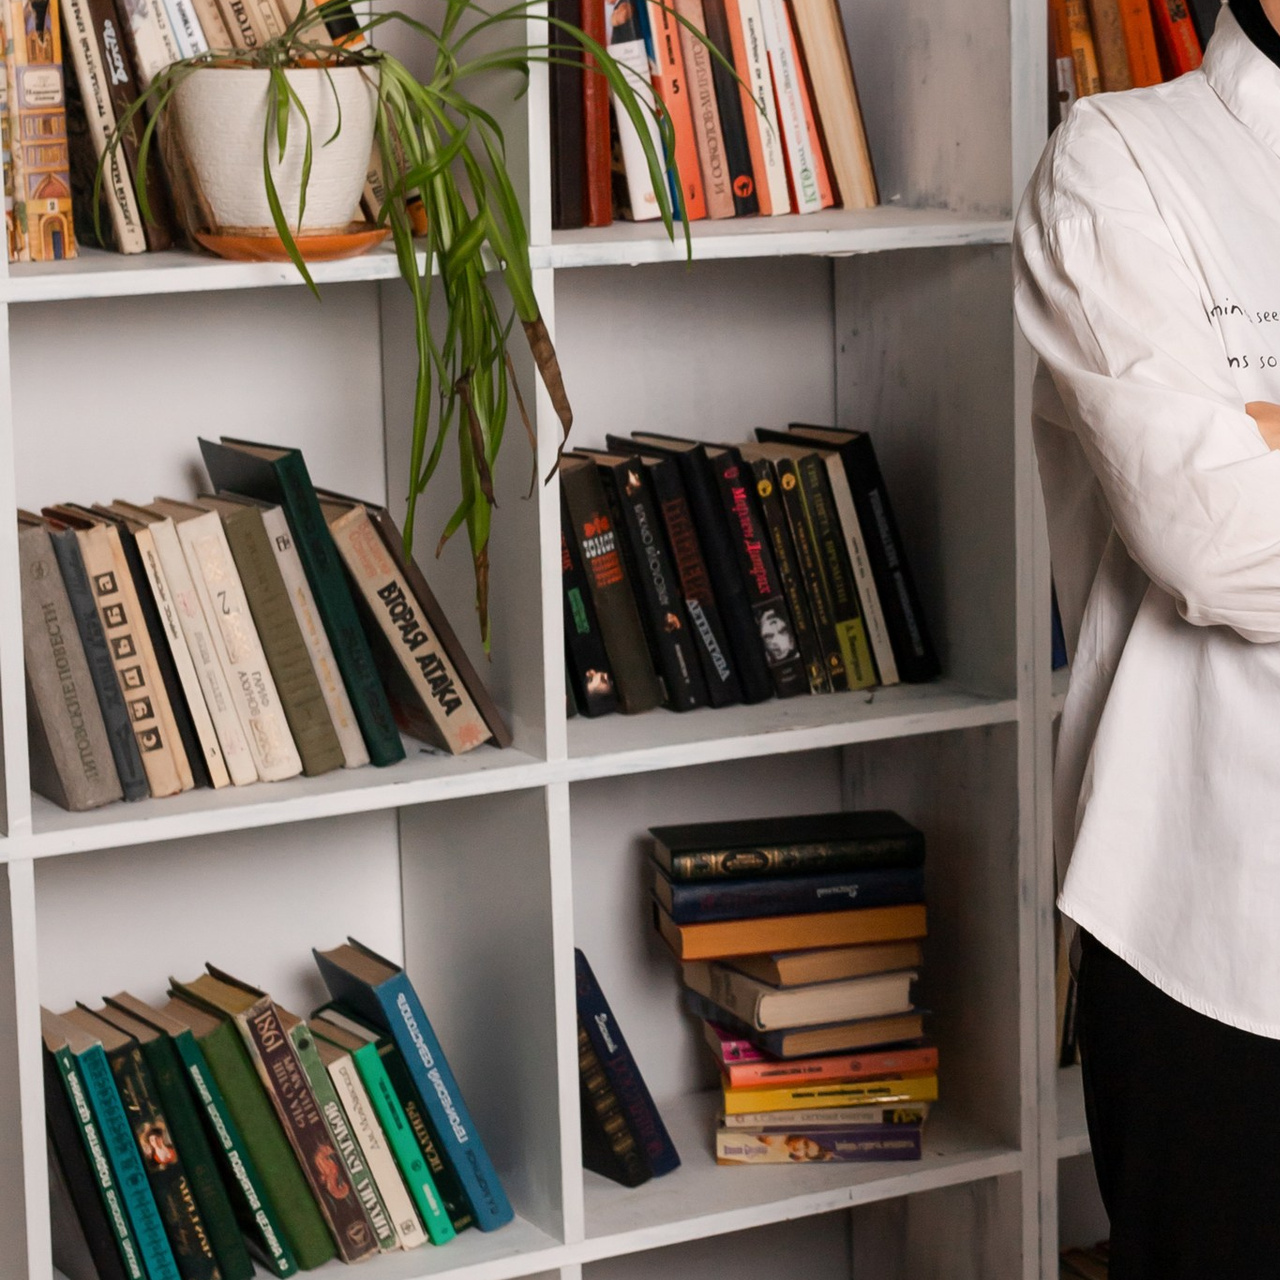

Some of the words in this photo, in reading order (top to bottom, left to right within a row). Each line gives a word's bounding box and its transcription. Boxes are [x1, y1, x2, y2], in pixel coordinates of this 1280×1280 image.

[1259, 355, 1278, 369] so
[39, 599, 74, 680] ПОВЕСТИ
[374, 578, 429, 652] ВТОРАЯ
[412, 645, 465, 716] АТАКА
[235, 668, 262, 717] АХУНОВ
[249, 668, 272, 707] ГАРИФ
[392, 991, 436, 1069] СЕВАСТОПОЛЬ
[66, 1069, 92, 1123] ЦЕЛИНА
[425, 1066, 469, 1145] ГЕРОИЧЕСКИЙ
[82, 1122, 114, 1188] ПОДНЯТАЯ
[321, 1099, 364, 1174] БУЛГАКОВ
[205, 1102, 234, 1150] ШОЛОХОВ
[225, 1149, 262, 1211] ПОДНЯТАЯ
[252, 1209, 284, 1259] ЦЕЛИНА
[354, 1176, 392, 1241] МИХАИЛ
